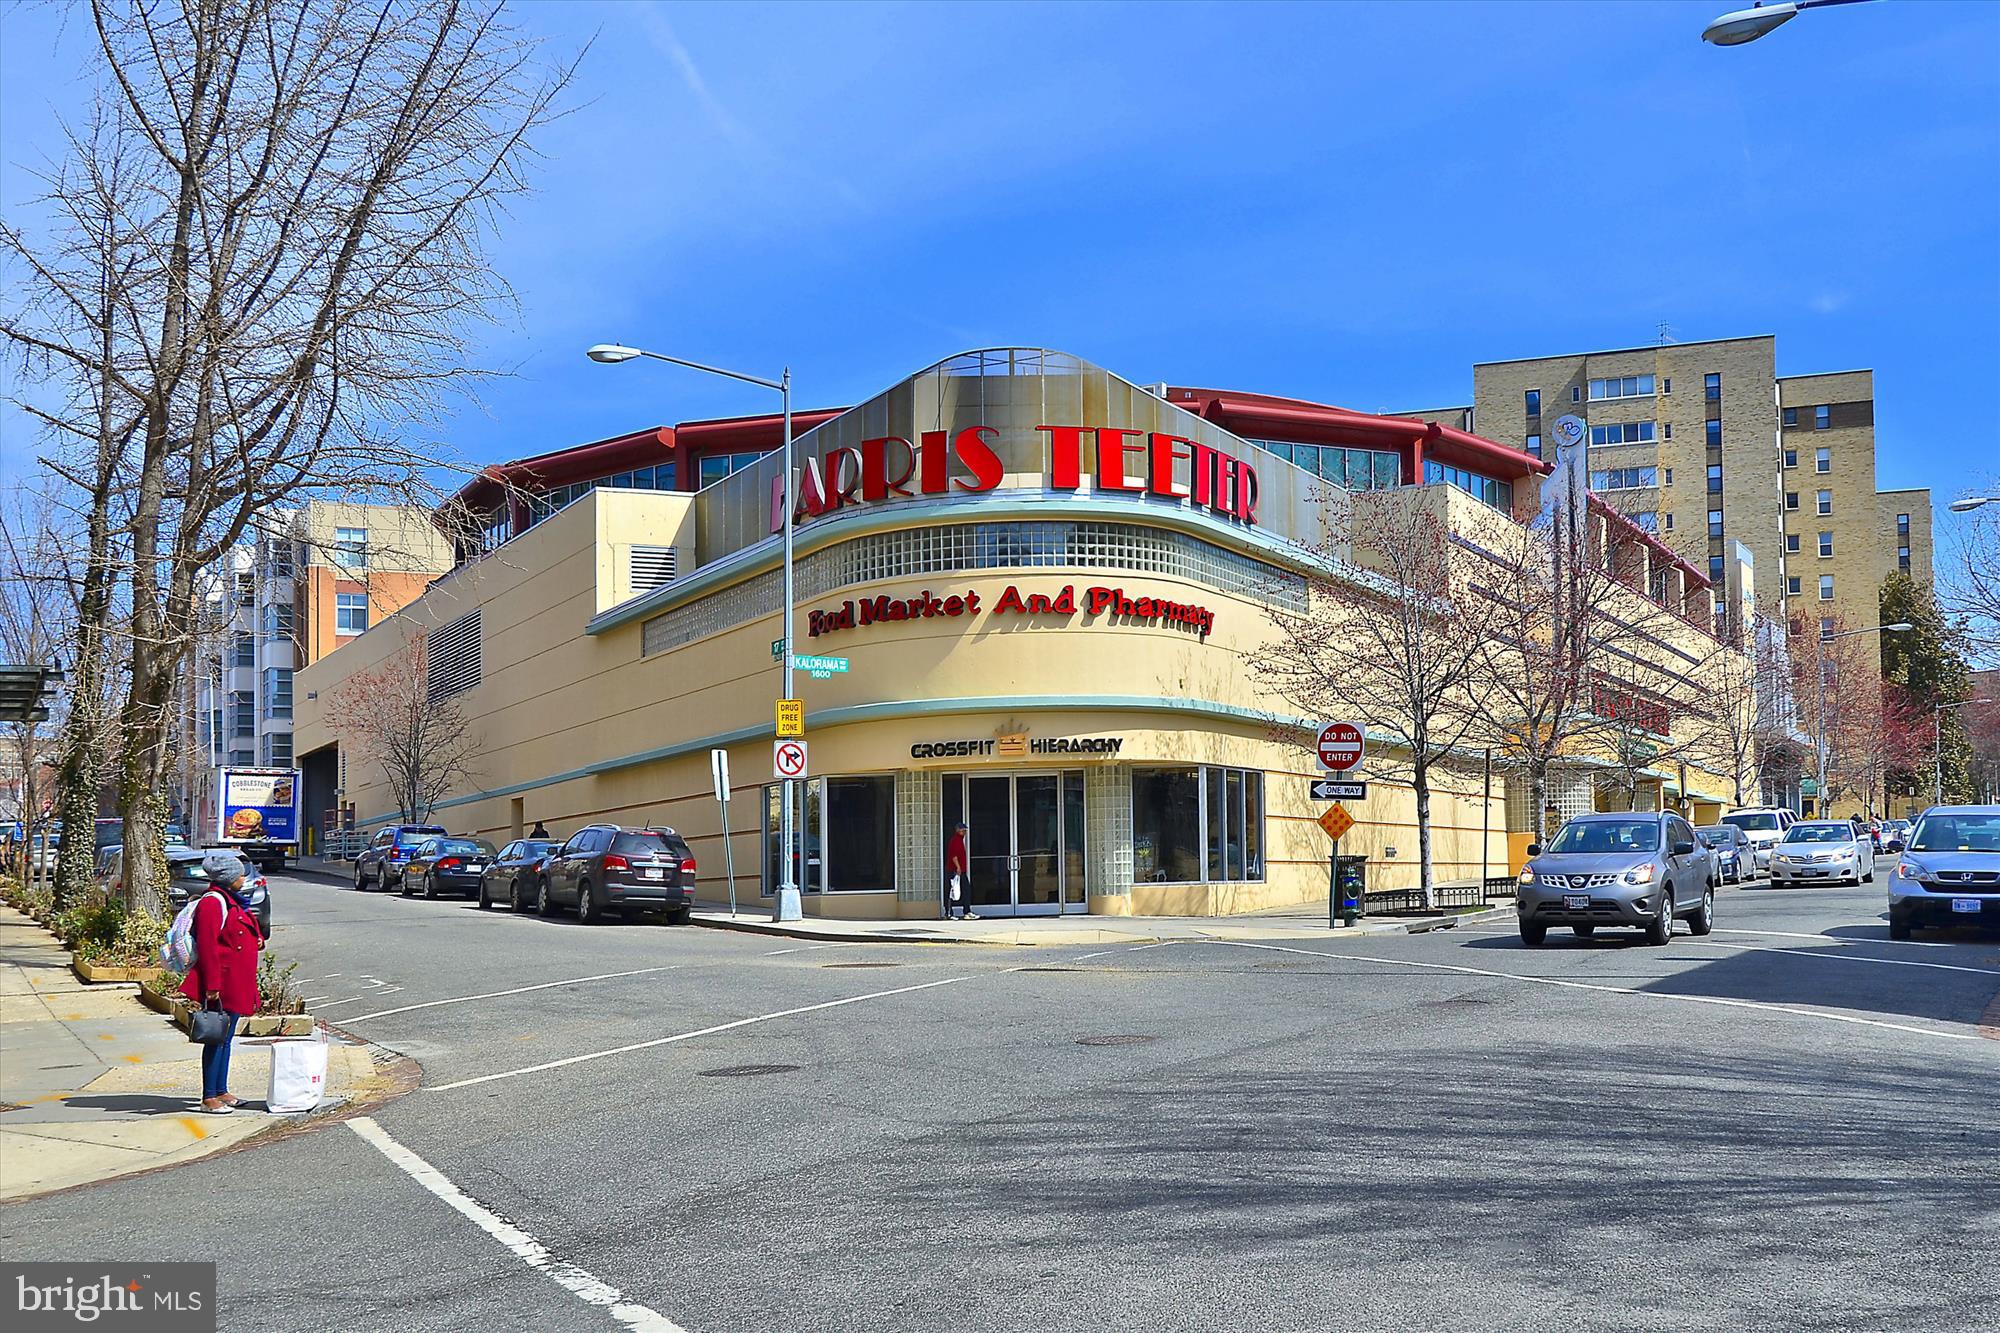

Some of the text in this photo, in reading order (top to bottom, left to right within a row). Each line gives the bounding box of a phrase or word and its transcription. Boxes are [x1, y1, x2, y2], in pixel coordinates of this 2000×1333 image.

[770, 425, 1258, 534] HARRIS TEETER
[808, 585, 1214, 637] Food Market And Pharmacy
[796, 657, 839, 671] KALORAMA
[811, 670, 831, 678] 1600
[780, 703, 799, 711] DRUG
[781, 713, 798, 721] FREE
[781, 723, 798, 731] ZONE
[1325, 732, 1357, 740] DO NOT
[911, 738, 1123, 758] CROSSFIT HIERARCHY
[1326, 753, 1353, 761] ENTER
[232, 780, 271, 788] COBBLESTONE
[1326, 786, 1360, 794] ONE WAY
